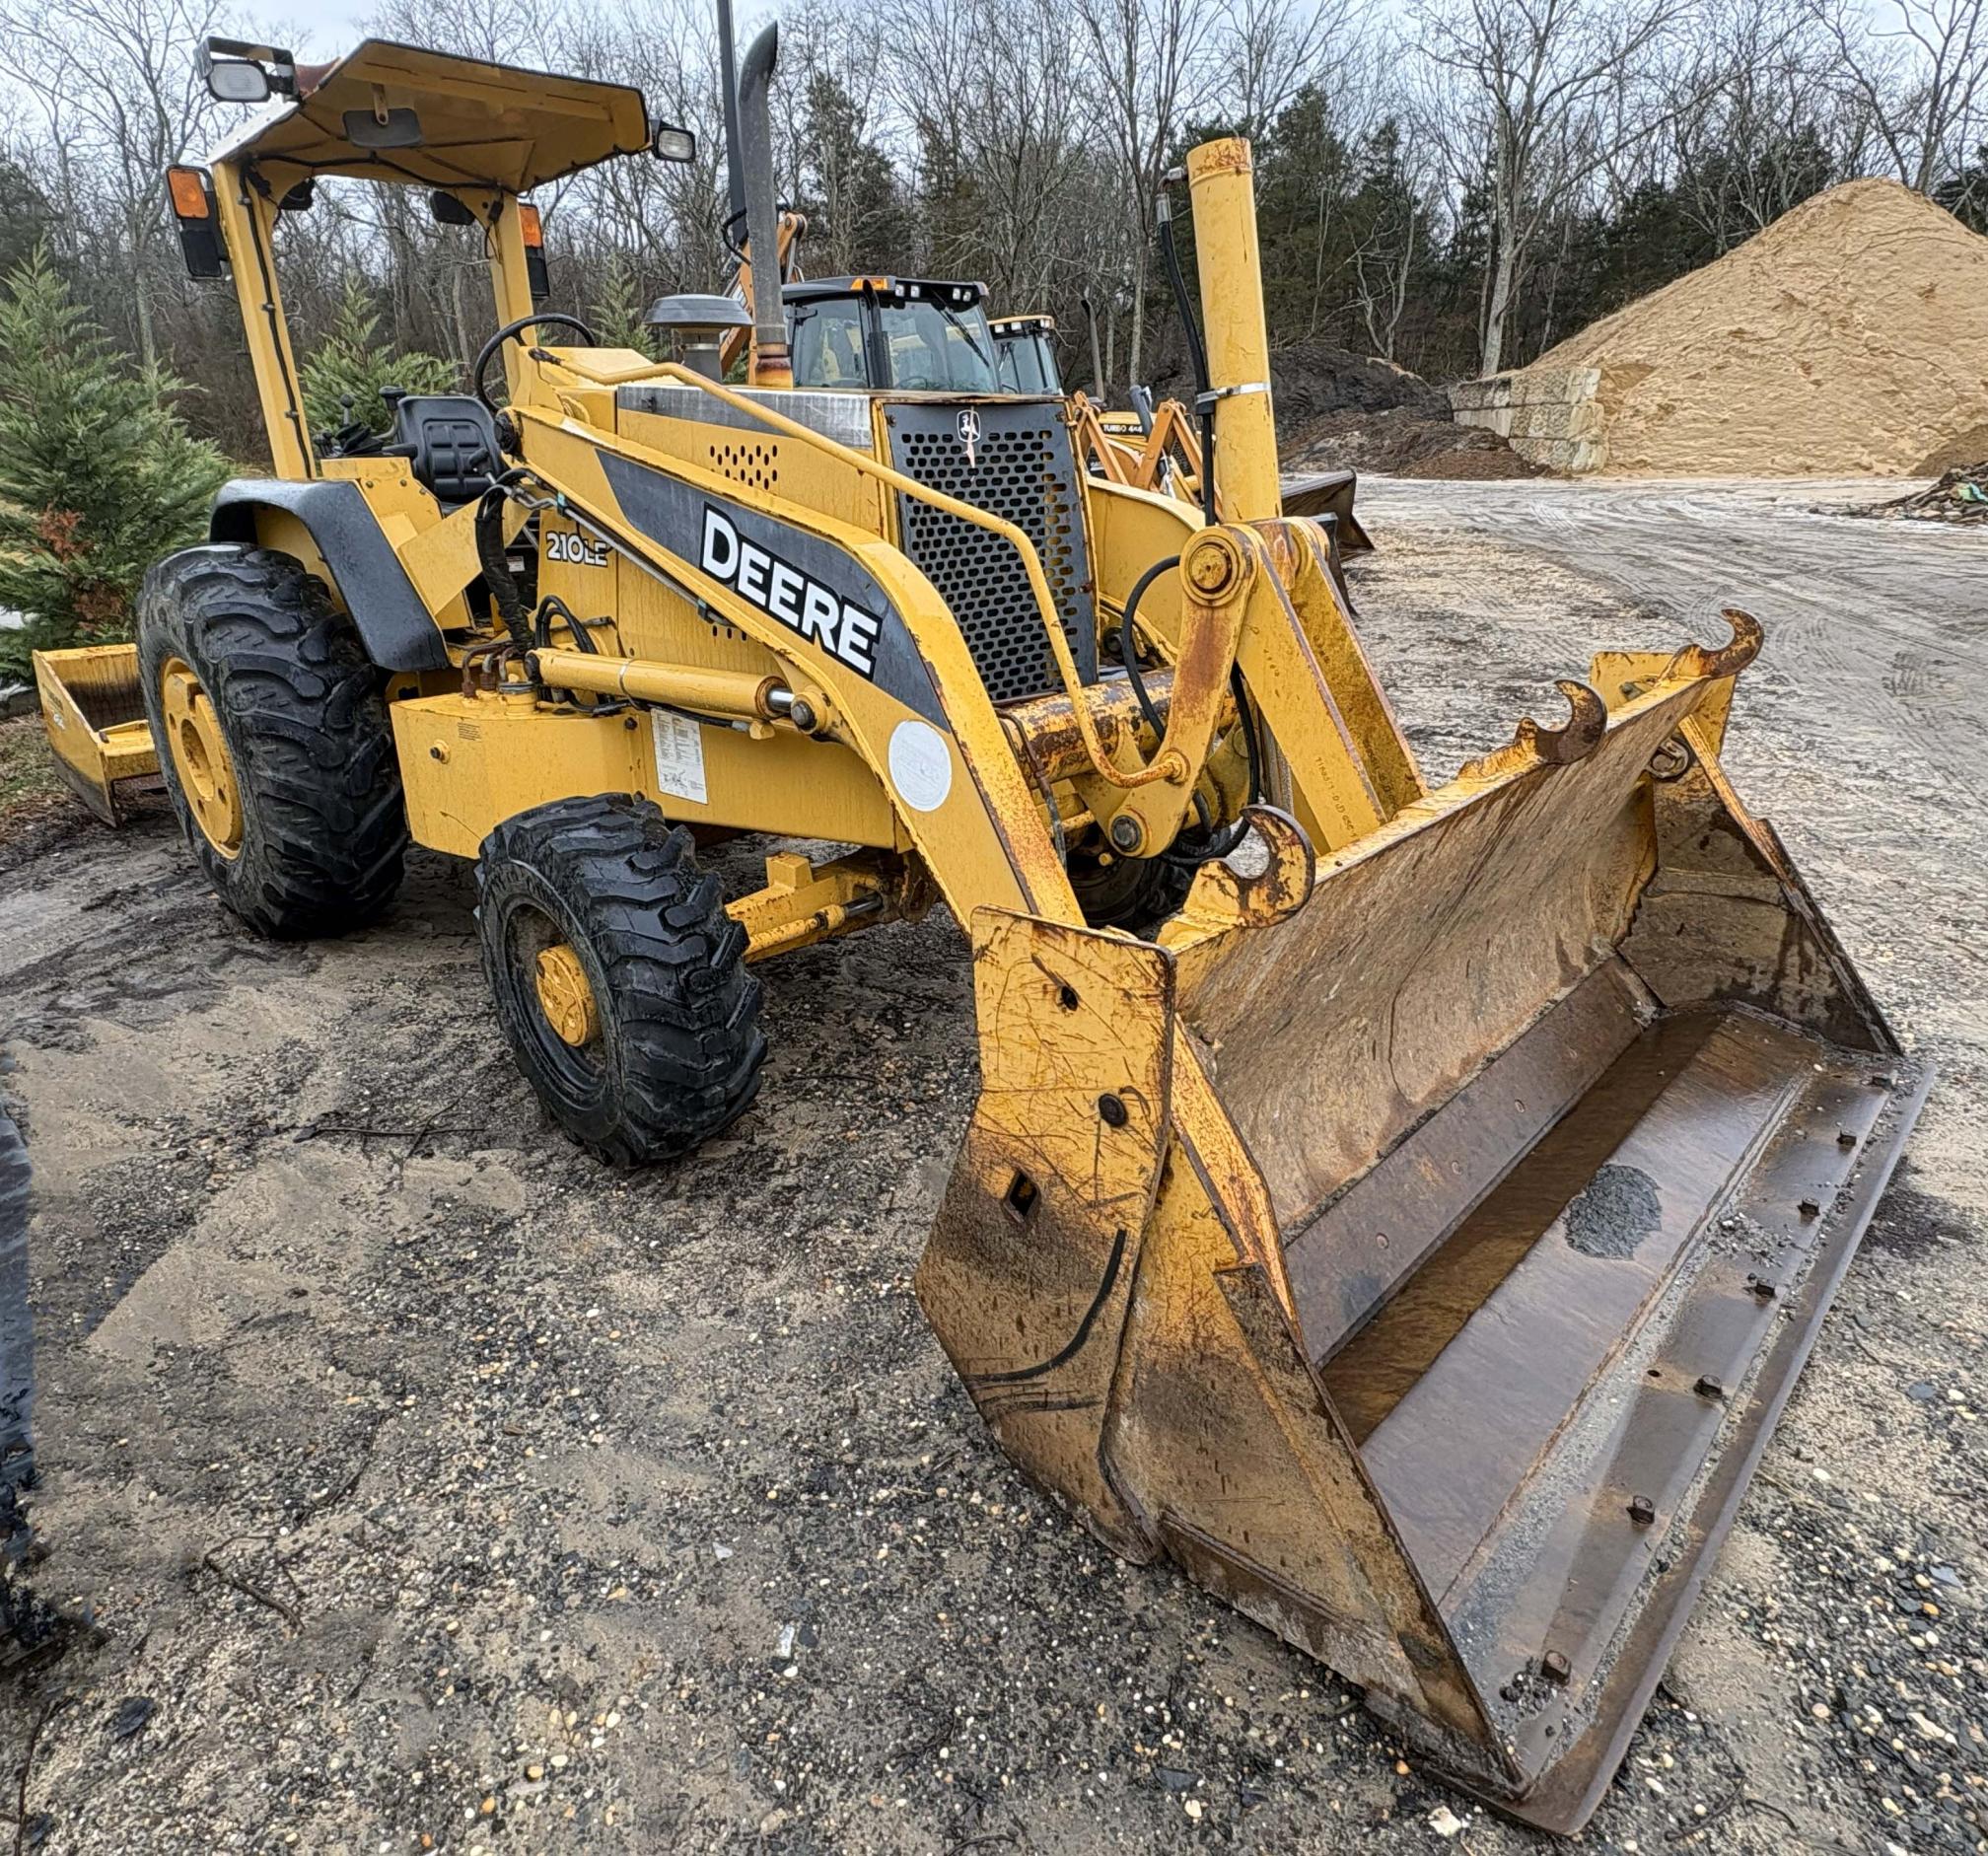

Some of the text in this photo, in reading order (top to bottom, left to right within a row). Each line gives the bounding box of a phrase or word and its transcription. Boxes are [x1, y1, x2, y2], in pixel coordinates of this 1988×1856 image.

[1102, 424, 1127, 433] TURBO
[546, 531, 608, 567] 210LE
[701, 505, 881, 678] DEERE
